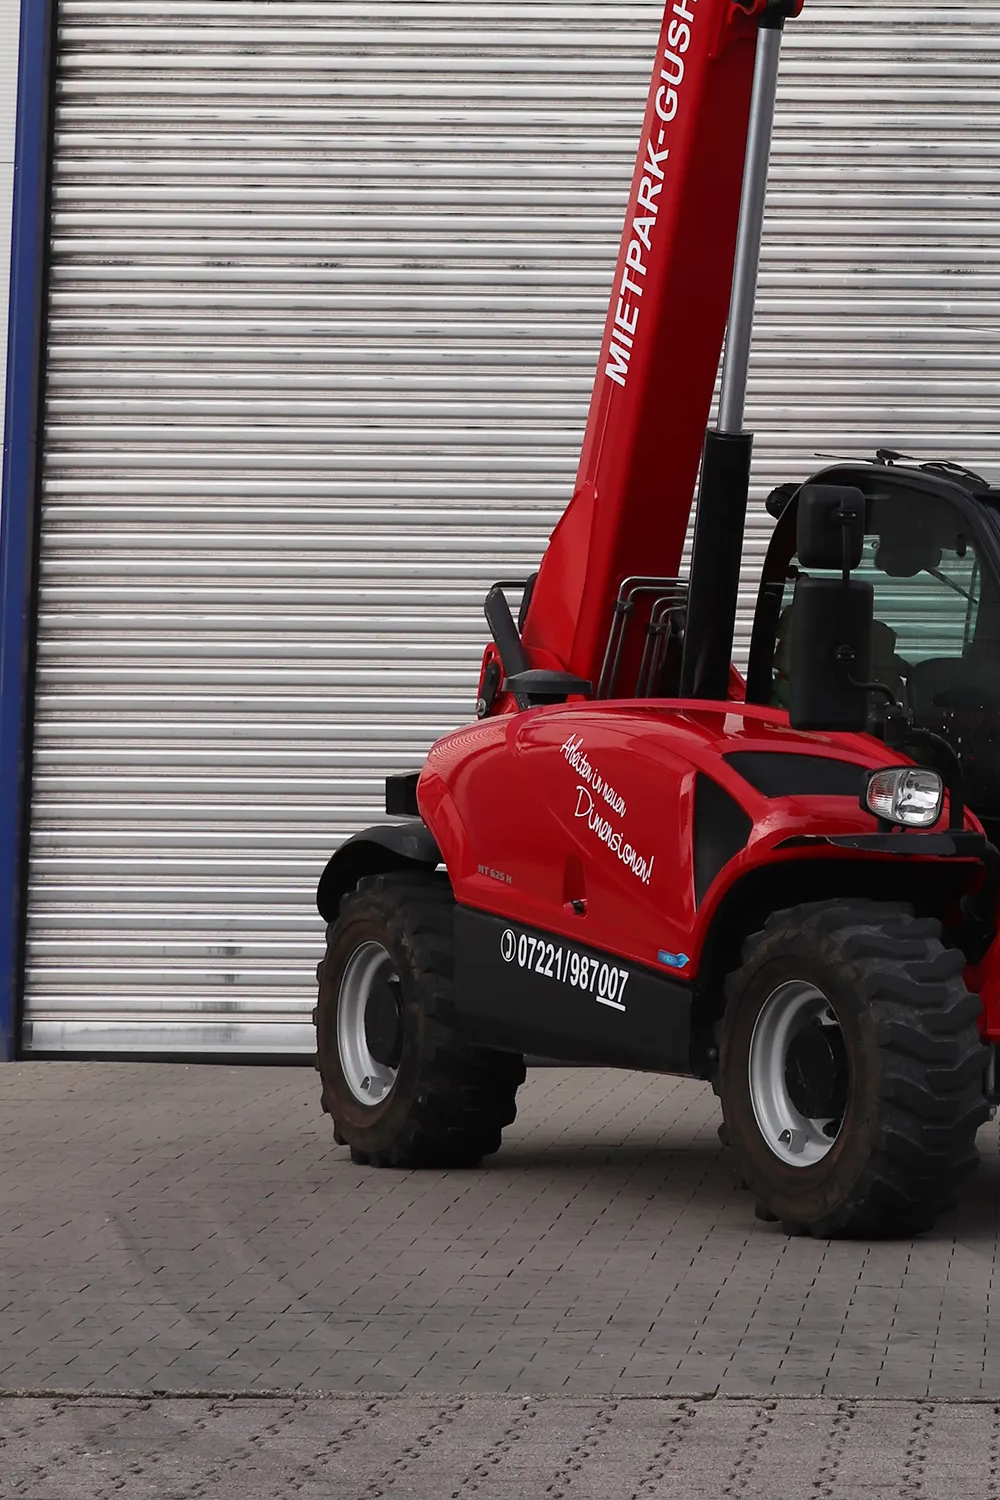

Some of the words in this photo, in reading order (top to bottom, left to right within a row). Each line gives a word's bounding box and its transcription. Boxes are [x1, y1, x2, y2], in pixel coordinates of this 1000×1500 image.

[560, 734, 593, 783] Arbeiten
[592, 769, 603, 794] in
[602, 782, 627, 818] neuen
[574, 785, 655, 885] Dimensionen!
[478, 864, 489, 876] MT
[490, 868, 505, 882] 625
[506, 873, 512, 885] H
[518, 934, 629, 1005] 07221/987007
